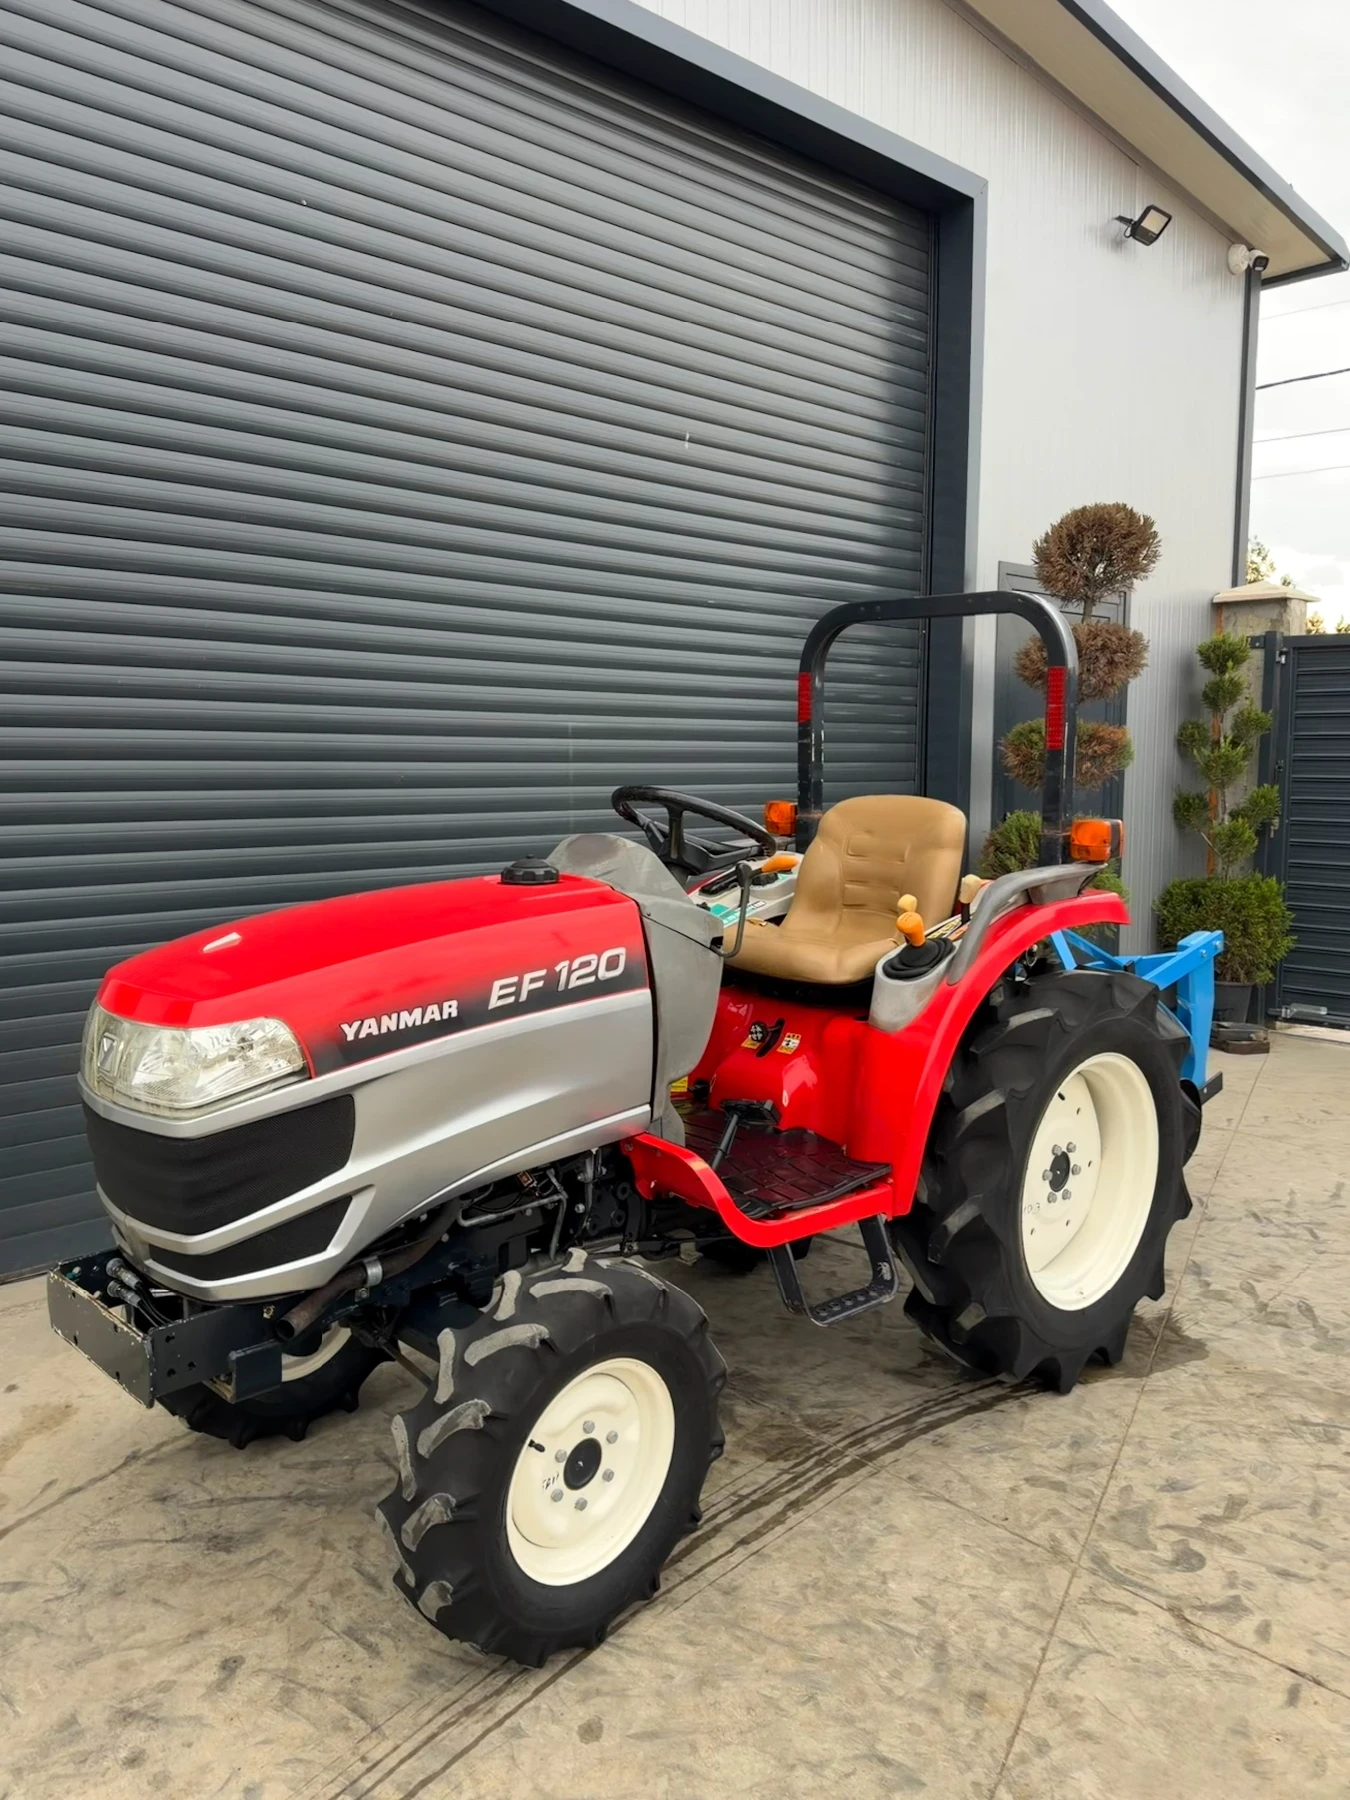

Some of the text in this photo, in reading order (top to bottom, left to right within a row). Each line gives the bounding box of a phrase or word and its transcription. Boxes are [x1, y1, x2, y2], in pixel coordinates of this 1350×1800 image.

[488, 946, 626, 1011] EF 120
[340, 999, 459, 1042] YANMAR
